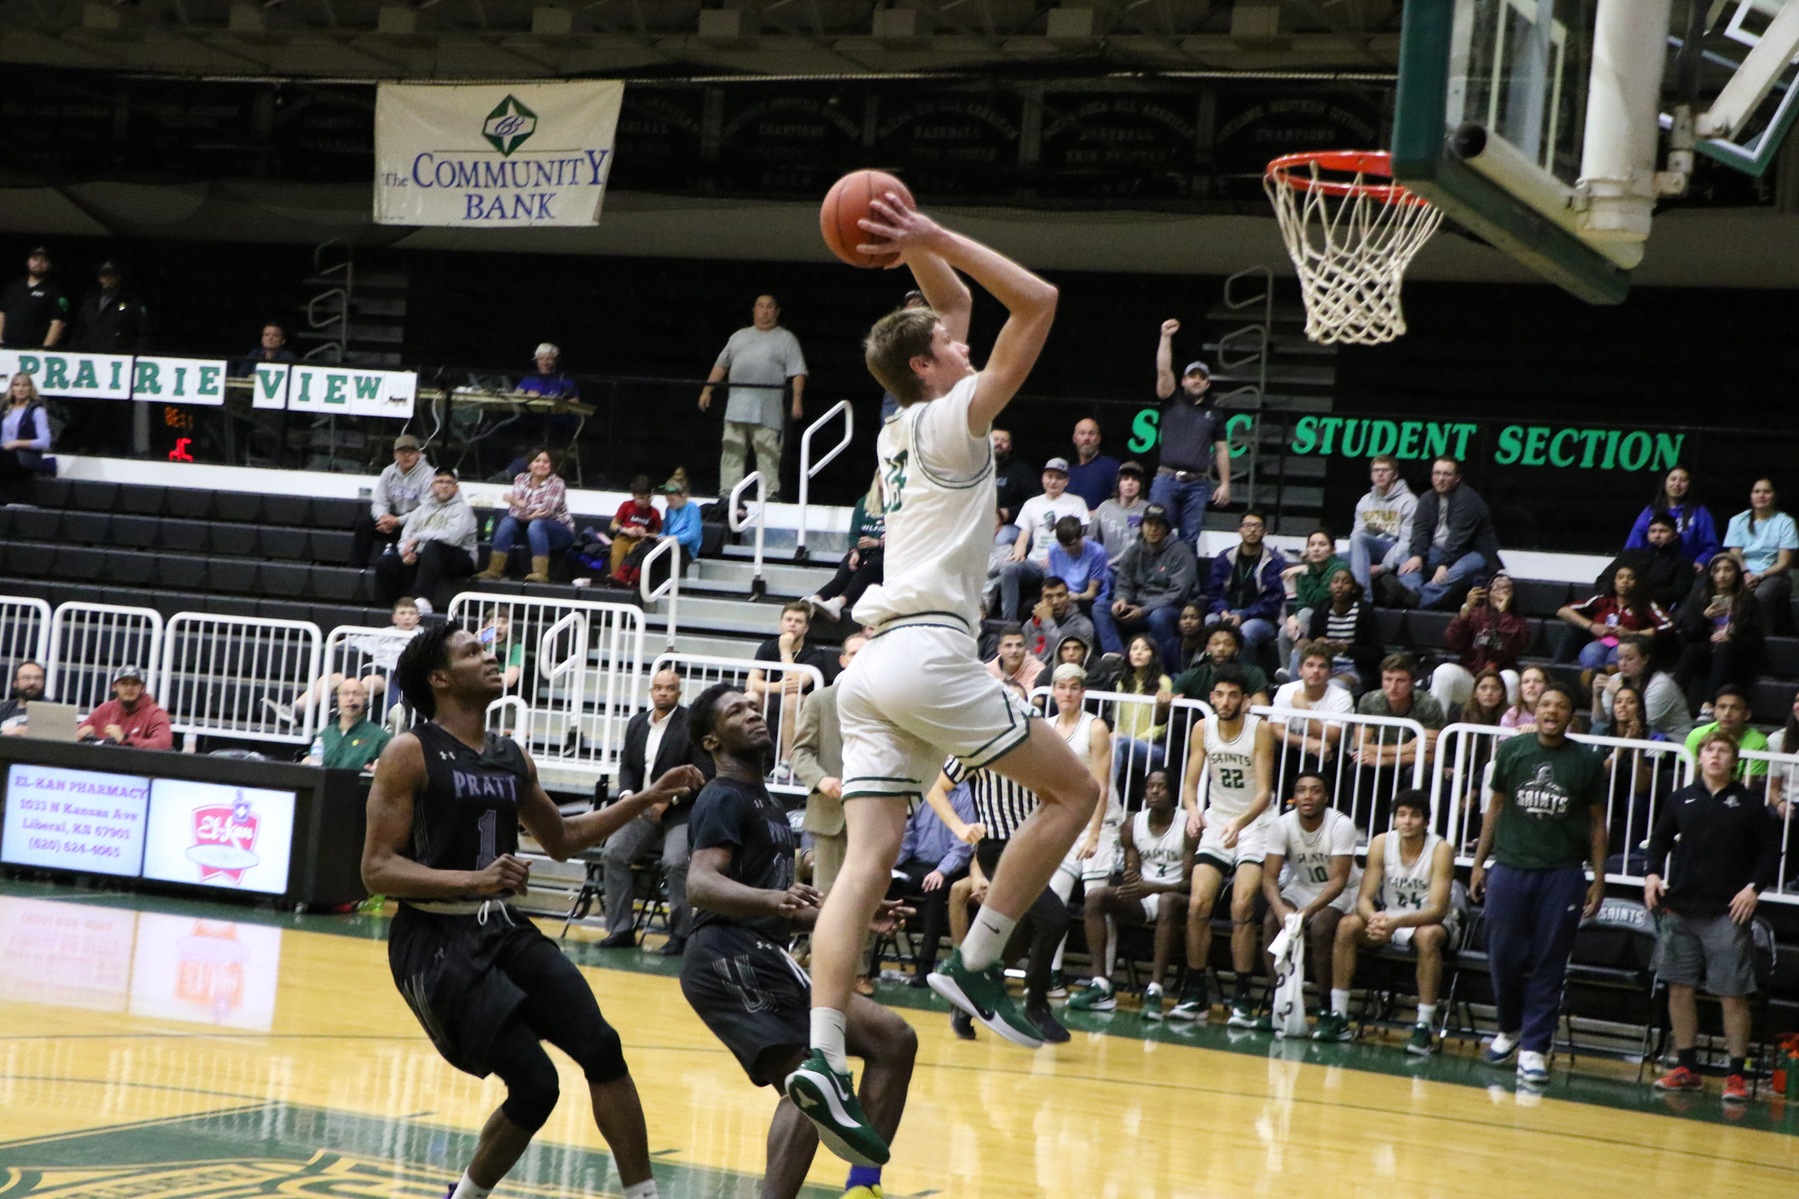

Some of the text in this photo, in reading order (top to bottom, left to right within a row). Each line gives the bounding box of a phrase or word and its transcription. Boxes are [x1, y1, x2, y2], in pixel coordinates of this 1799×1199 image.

[382, 149, 608, 189] The COMMUNITY
[462, 193, 557, 221] BANK
[18, 355, 382, 404] PRAIRIE VIEW
[1128, 410, 1686, 472] SC STUDENT SECTION
[1209, 753, 1252, 767] SAINTS
[15, 776, 147, 800] EL-KAN PHARMACY
[452, 769, 517, 803] PRATT
[1220, 768, 1245, 789] 22
[63, 805, 108, 819] Kansas
[112, 809, 138, 821] Ave
[1516, 789, 1568, 813] SAINTS
[22, 818, 69, 835] Liberal,
[72, 823, 92, 835] KS
[476, 809, 497, 870] 1
[1308, 867, 1329, 883] 10
[1598, 906, 1647, 925] SAINTS
